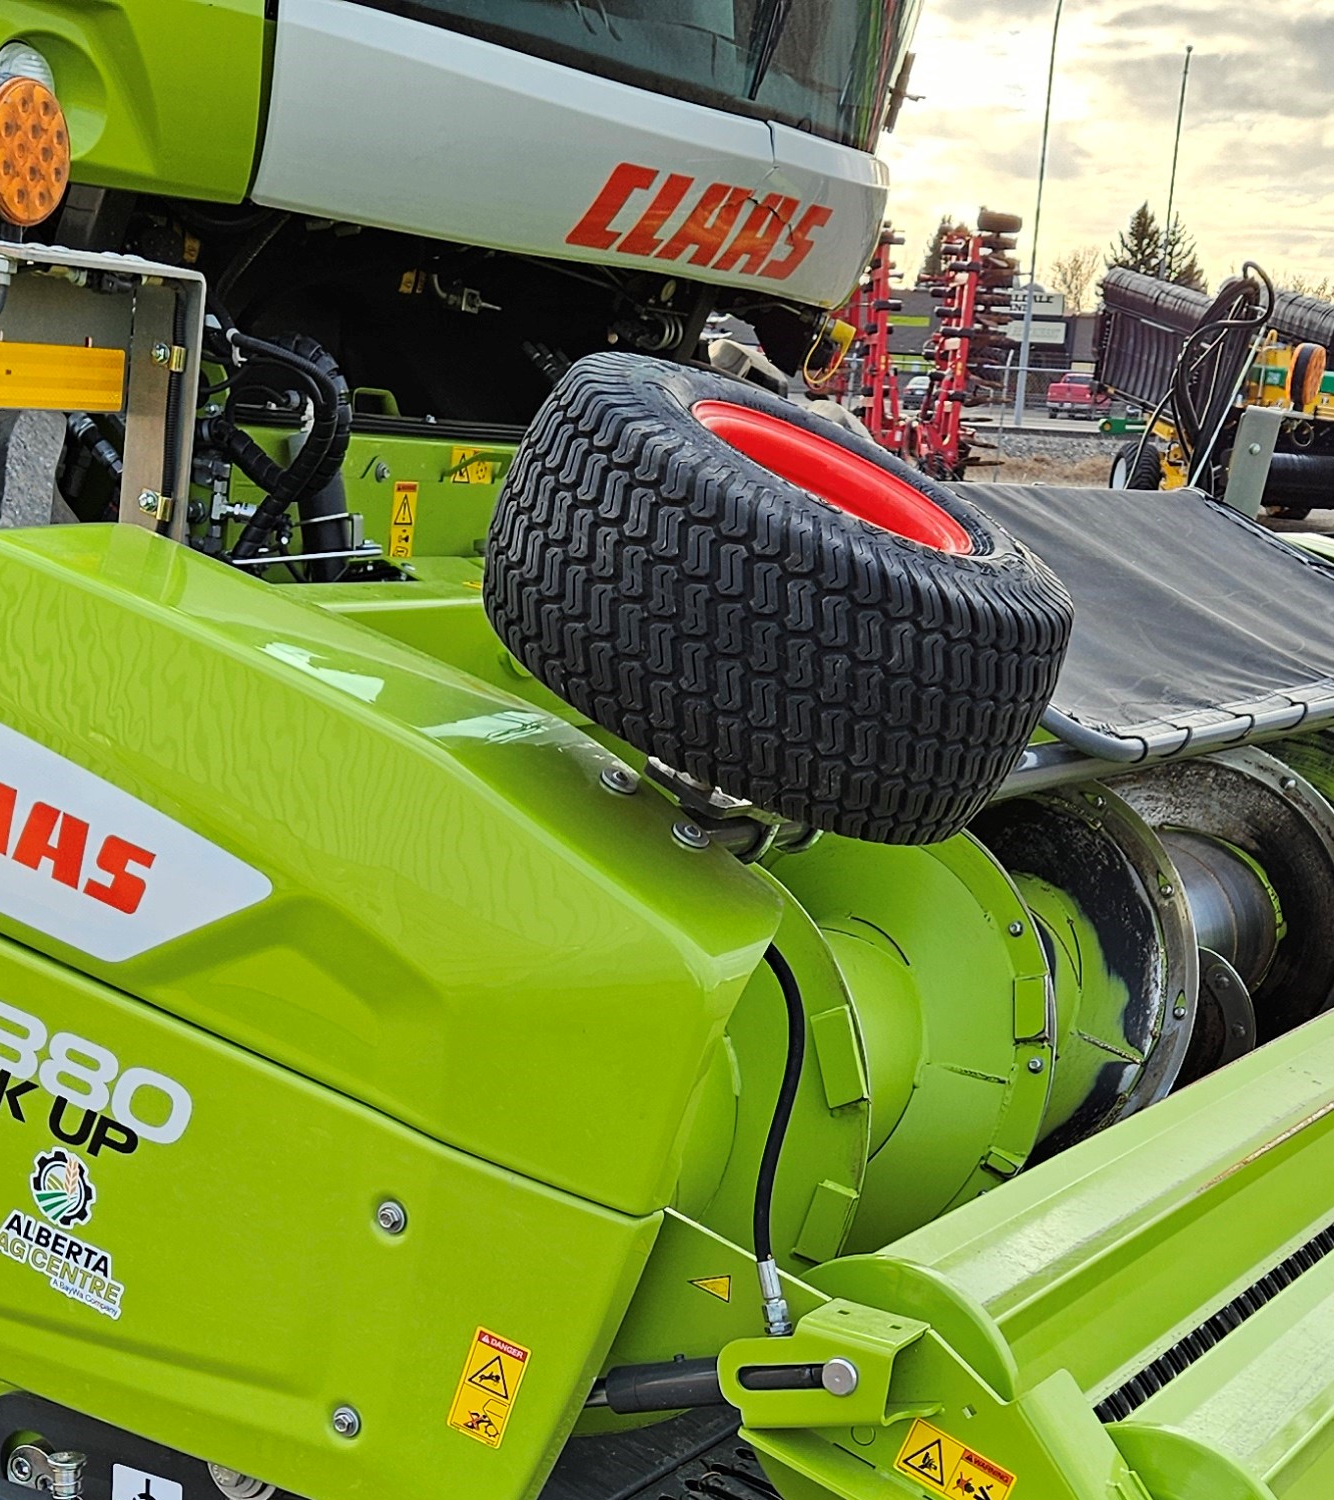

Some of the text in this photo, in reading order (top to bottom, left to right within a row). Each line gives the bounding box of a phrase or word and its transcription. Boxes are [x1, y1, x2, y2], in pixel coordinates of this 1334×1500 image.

[565, 162, 834, 281] CLAAS
[48, 1093, 140, 1157] UP
[5, 1213, 109, 1278] ALBERTA
[29, 1247, 121, 1306] CENTRE
[85, 1294, 118, 1317] Company
[489, 1338, 524, 1359] DANGER
[973, 1456, 1009, 1484] WARNING
